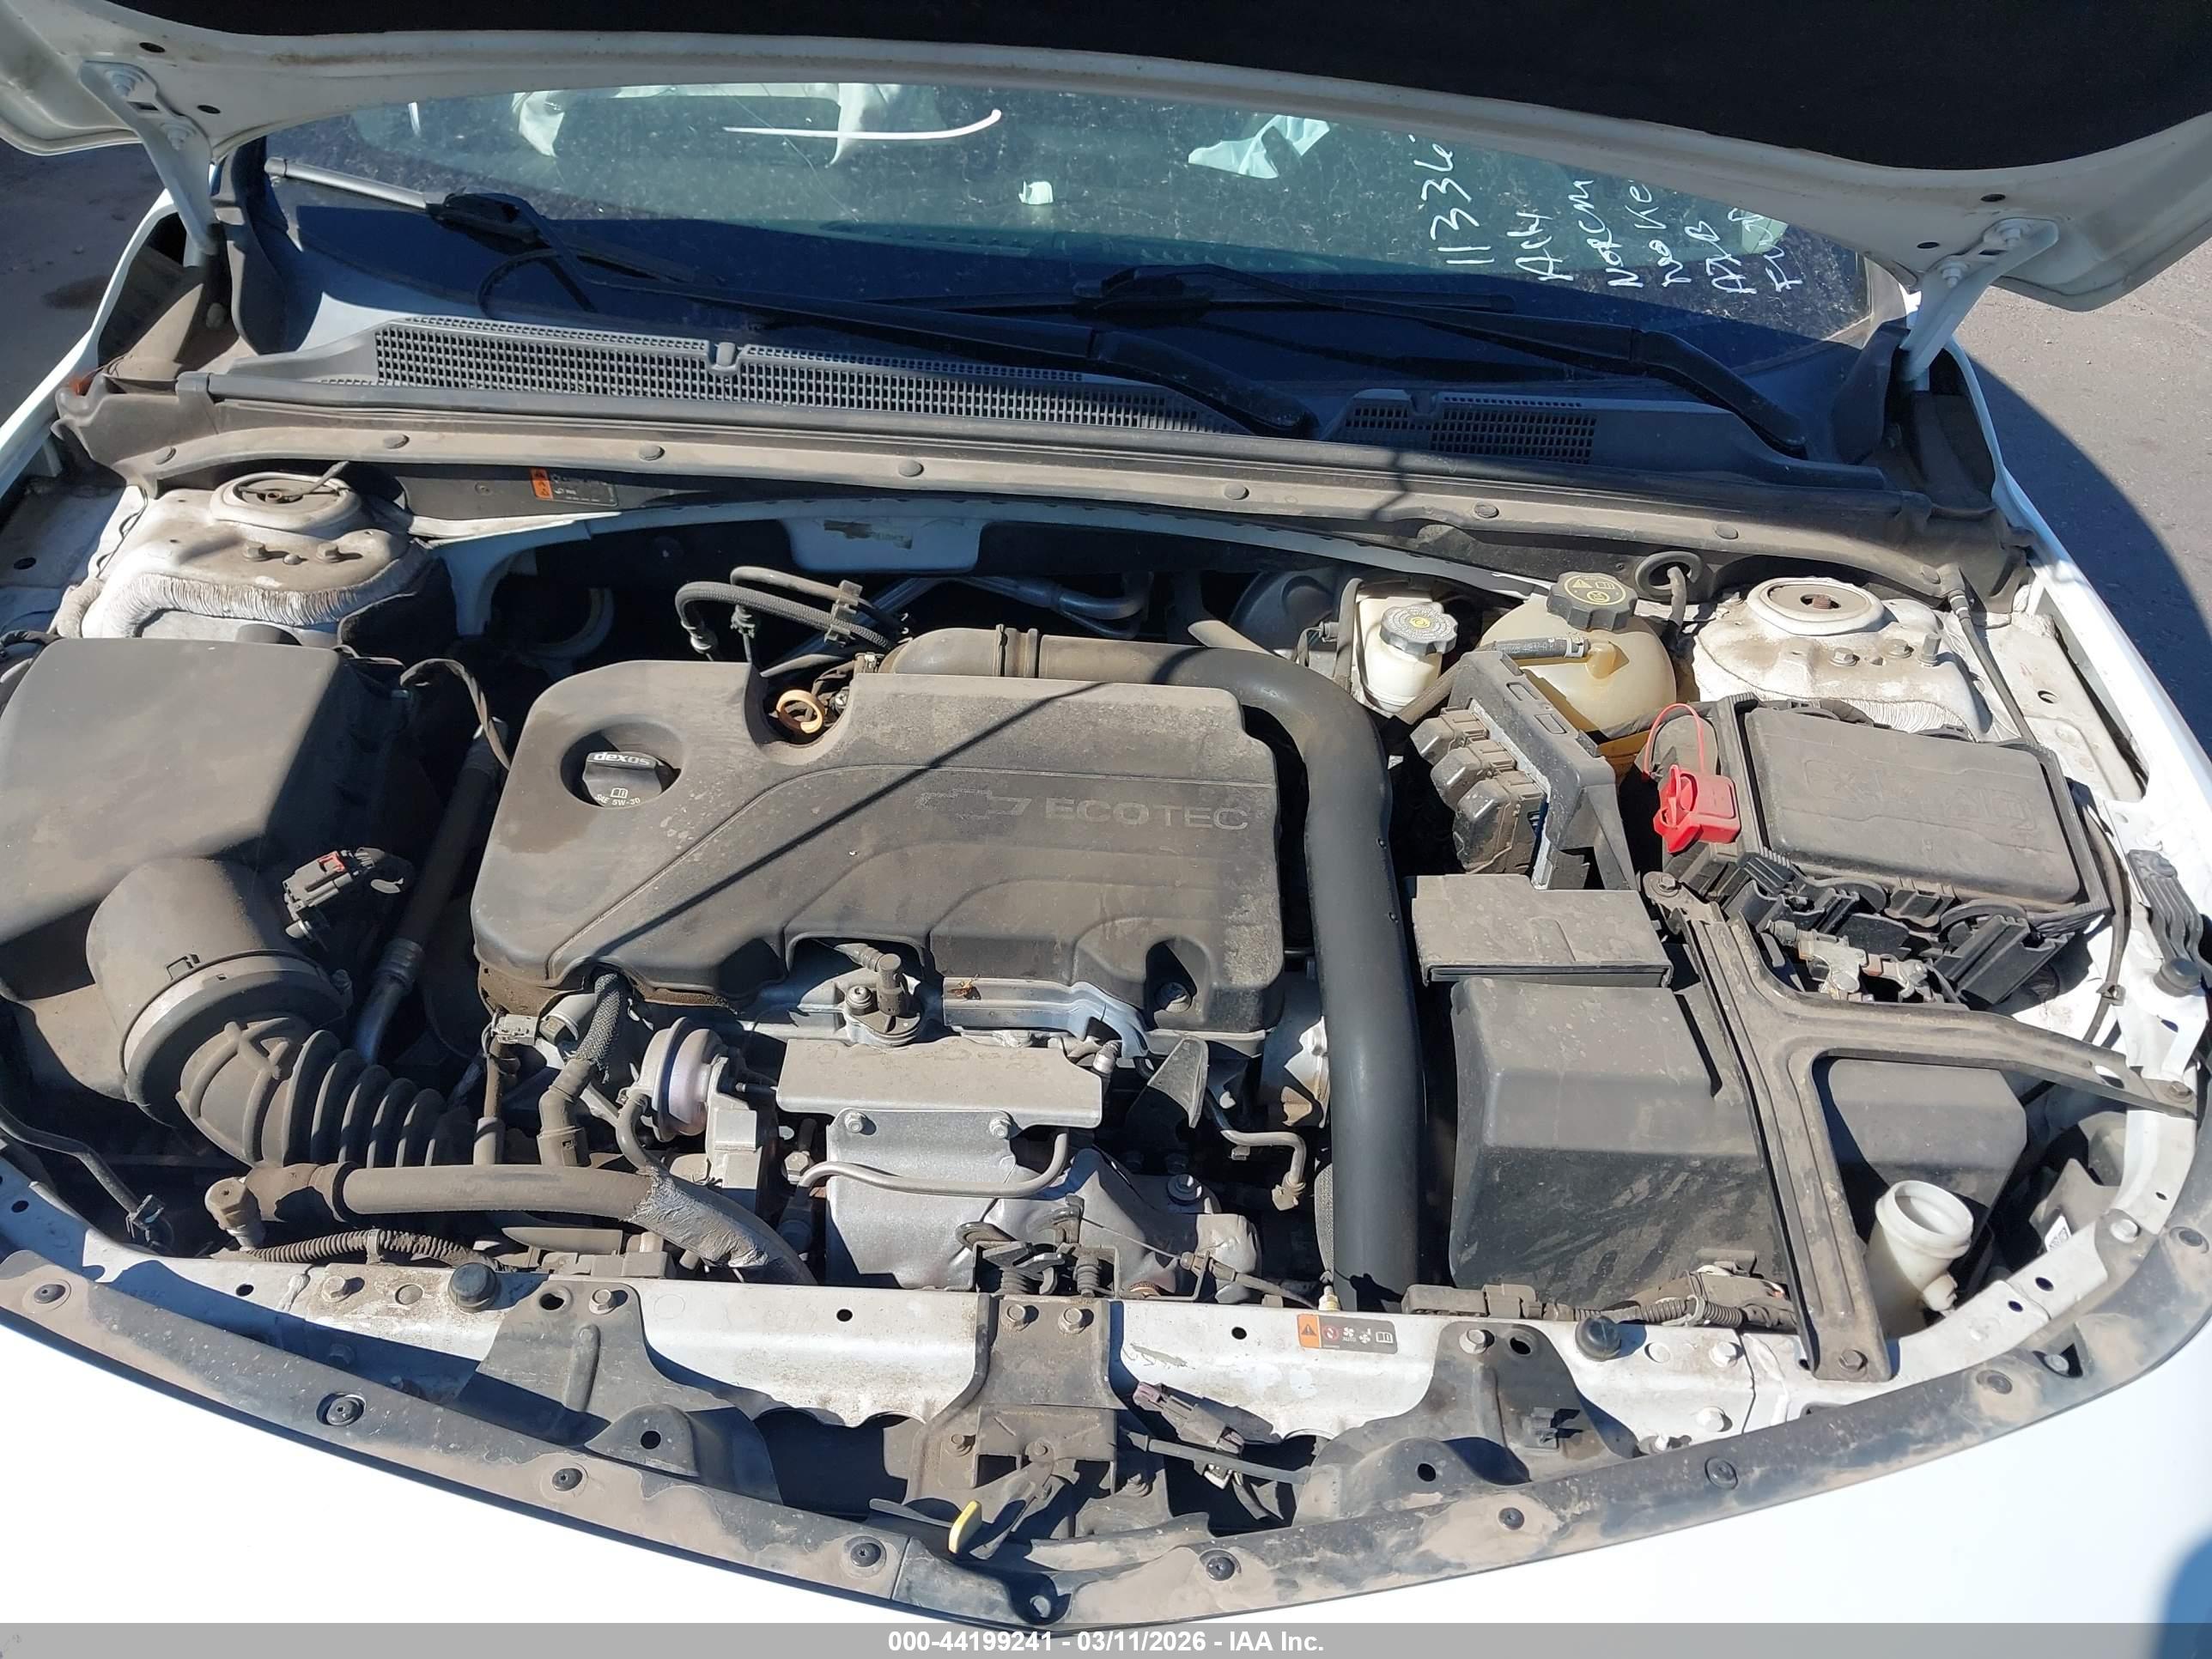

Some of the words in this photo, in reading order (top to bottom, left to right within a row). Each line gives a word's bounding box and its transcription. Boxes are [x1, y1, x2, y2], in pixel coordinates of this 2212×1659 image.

[1624, 179, 1668, 230] Ke
[593, 752, 650, 766] dexos
[594, 793, 611, 804] SAE
[611, 797, 641, 806] 5W-30
[1044, 797, 1249, 830] ECOTEC
